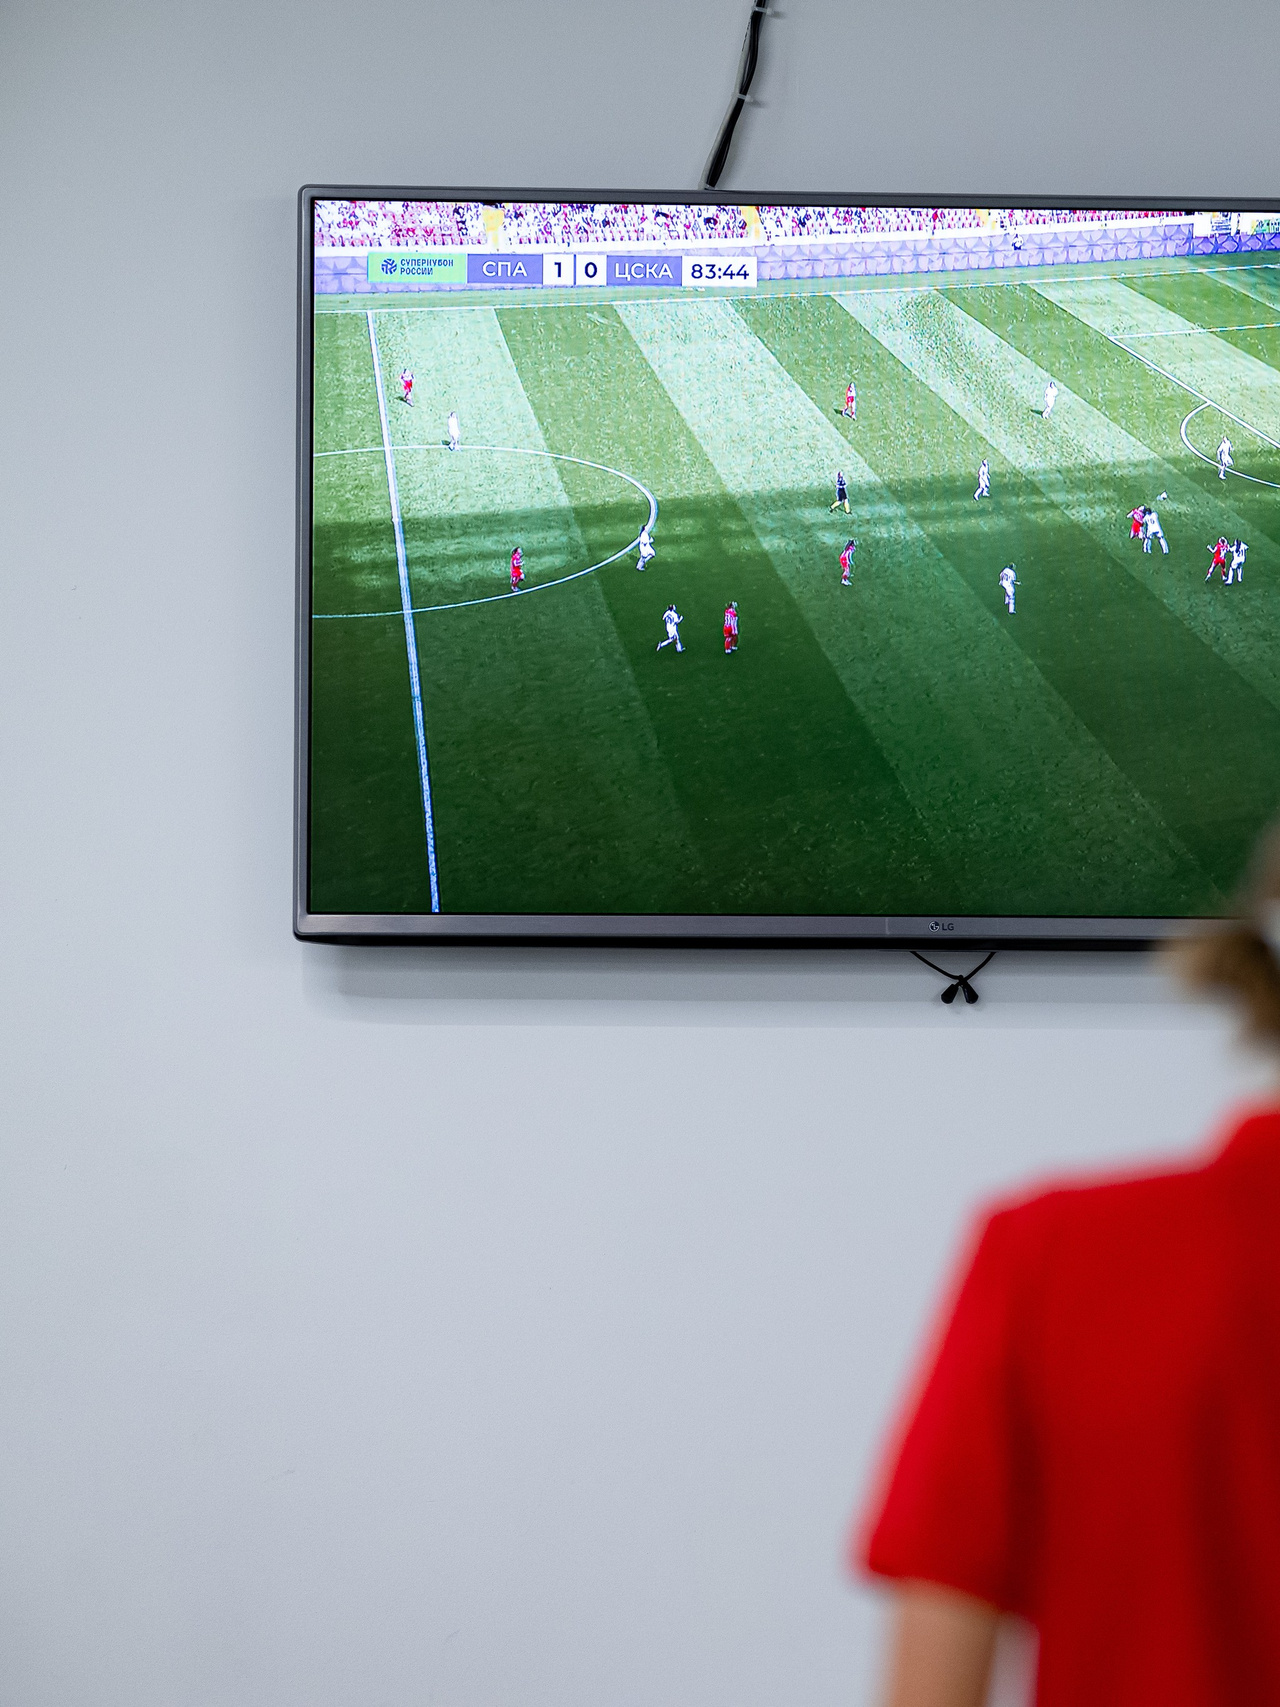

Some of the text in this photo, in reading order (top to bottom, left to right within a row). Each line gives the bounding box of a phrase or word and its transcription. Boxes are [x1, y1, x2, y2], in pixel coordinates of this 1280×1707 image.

[400, 267, 433, 275] РОССИИ
[482, 261, 750, 281] СПА 1 0 ЦСКА 83:44
